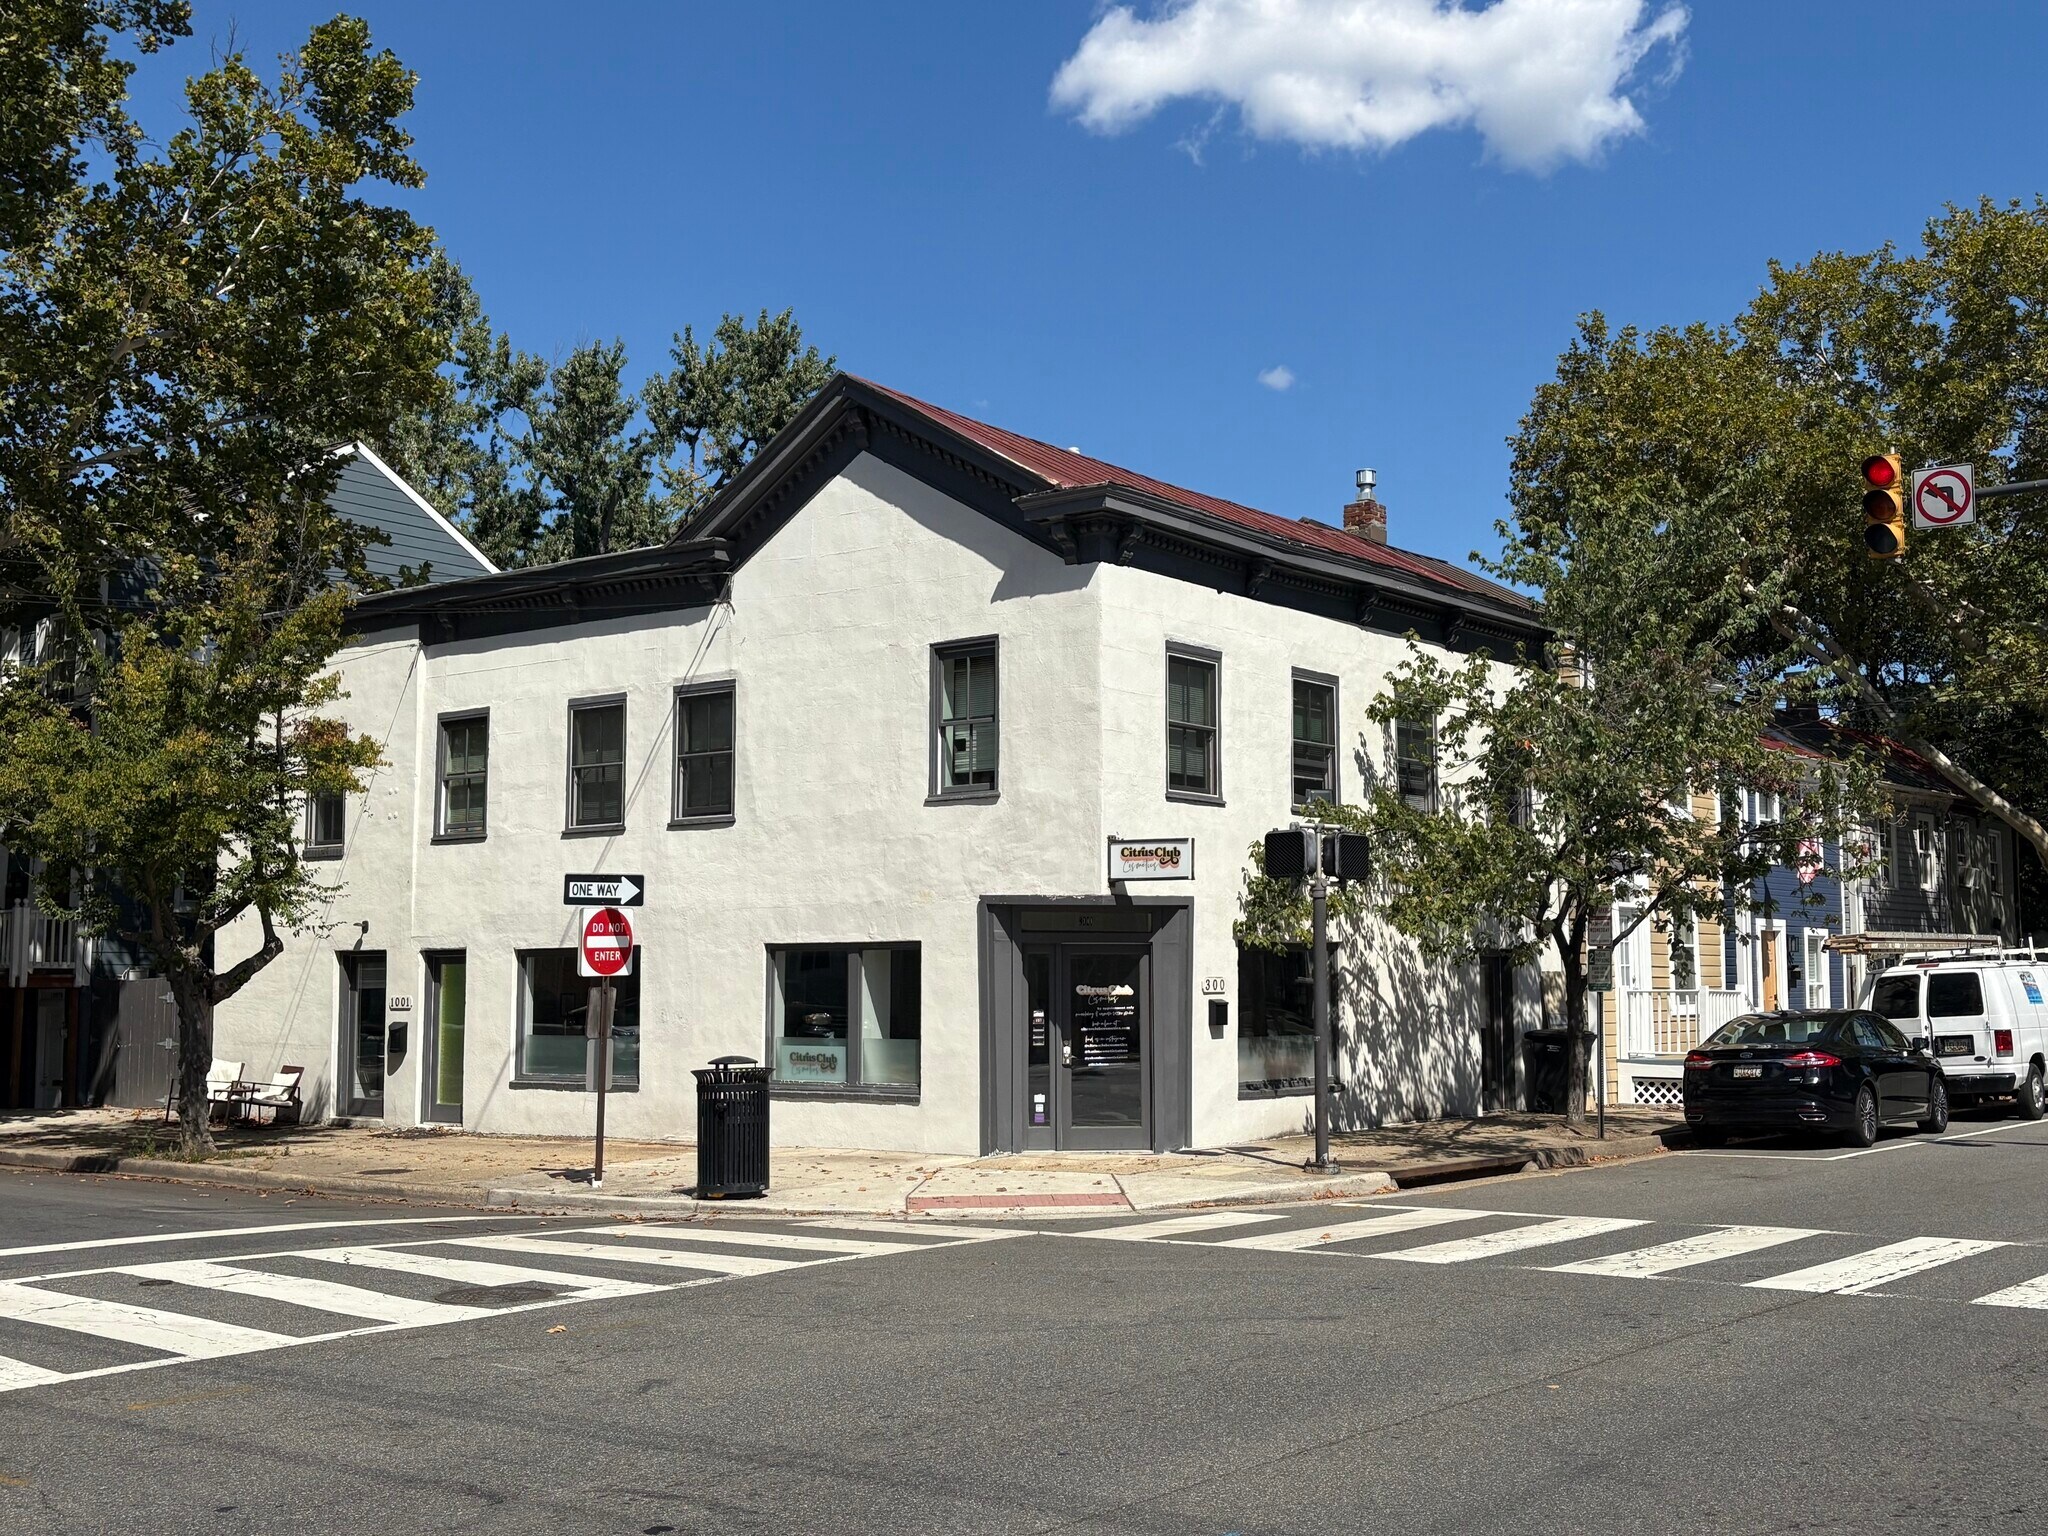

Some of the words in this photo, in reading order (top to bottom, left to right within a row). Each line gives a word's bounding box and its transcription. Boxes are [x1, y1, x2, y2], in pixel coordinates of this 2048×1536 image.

[571, 883, 593, 897] ONE
[597, 883, 620, 897] WAY
[592, 922, 605, 933] DO
[608, 922, 626, 933] NOT
[594, 951, 621, 962] ENTER
[1589, 952, 1595, 963] 2
[1205, 979, 1225, 991] 300
[390, 997, 410, 1007] 1001
